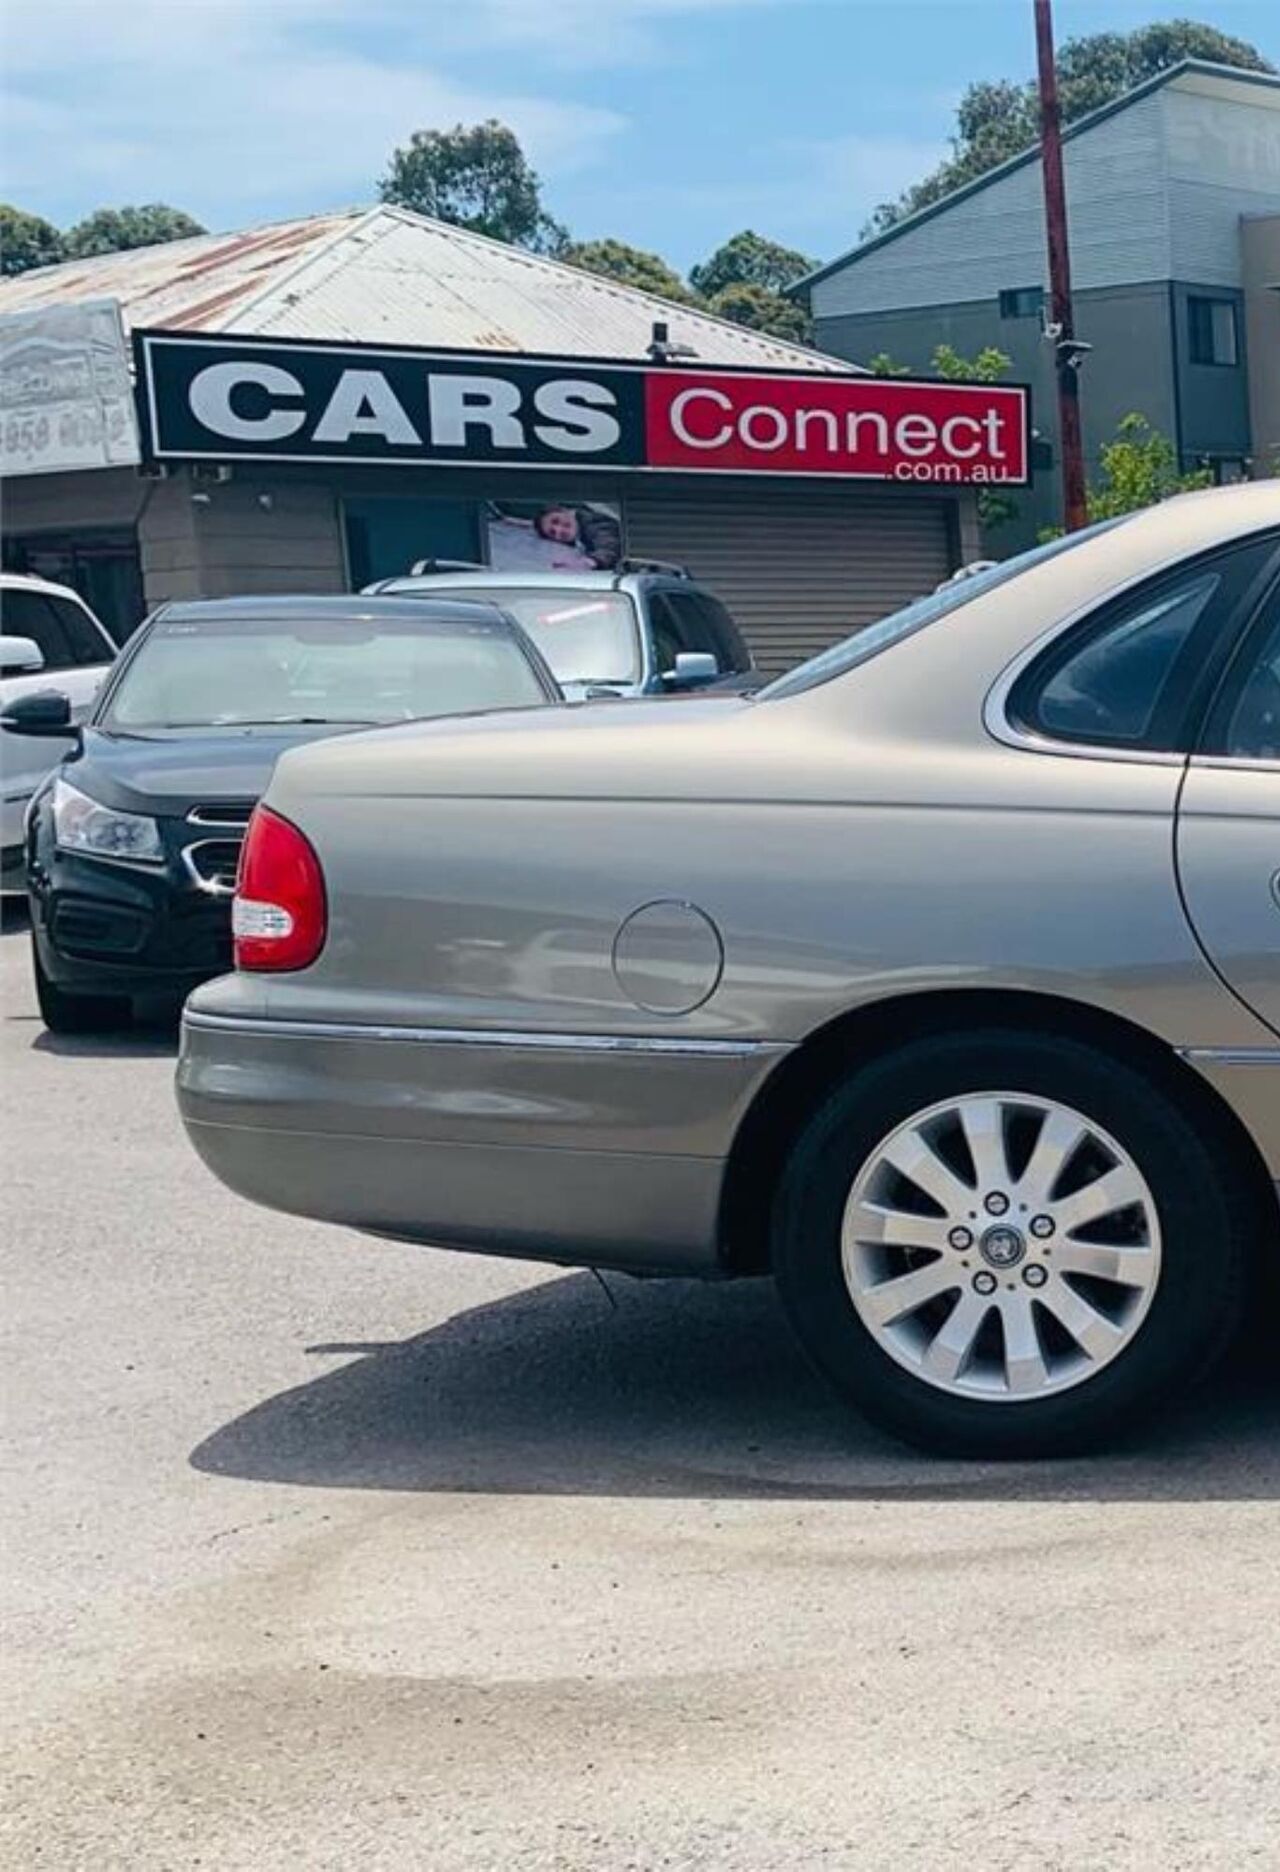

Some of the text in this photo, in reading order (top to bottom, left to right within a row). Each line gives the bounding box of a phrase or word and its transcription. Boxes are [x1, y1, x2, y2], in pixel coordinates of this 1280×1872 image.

[188, 360, 621, 452] CARS
[669, 387, 1006, 459] Connect
[884, 460, 1008, 483] .com.au
